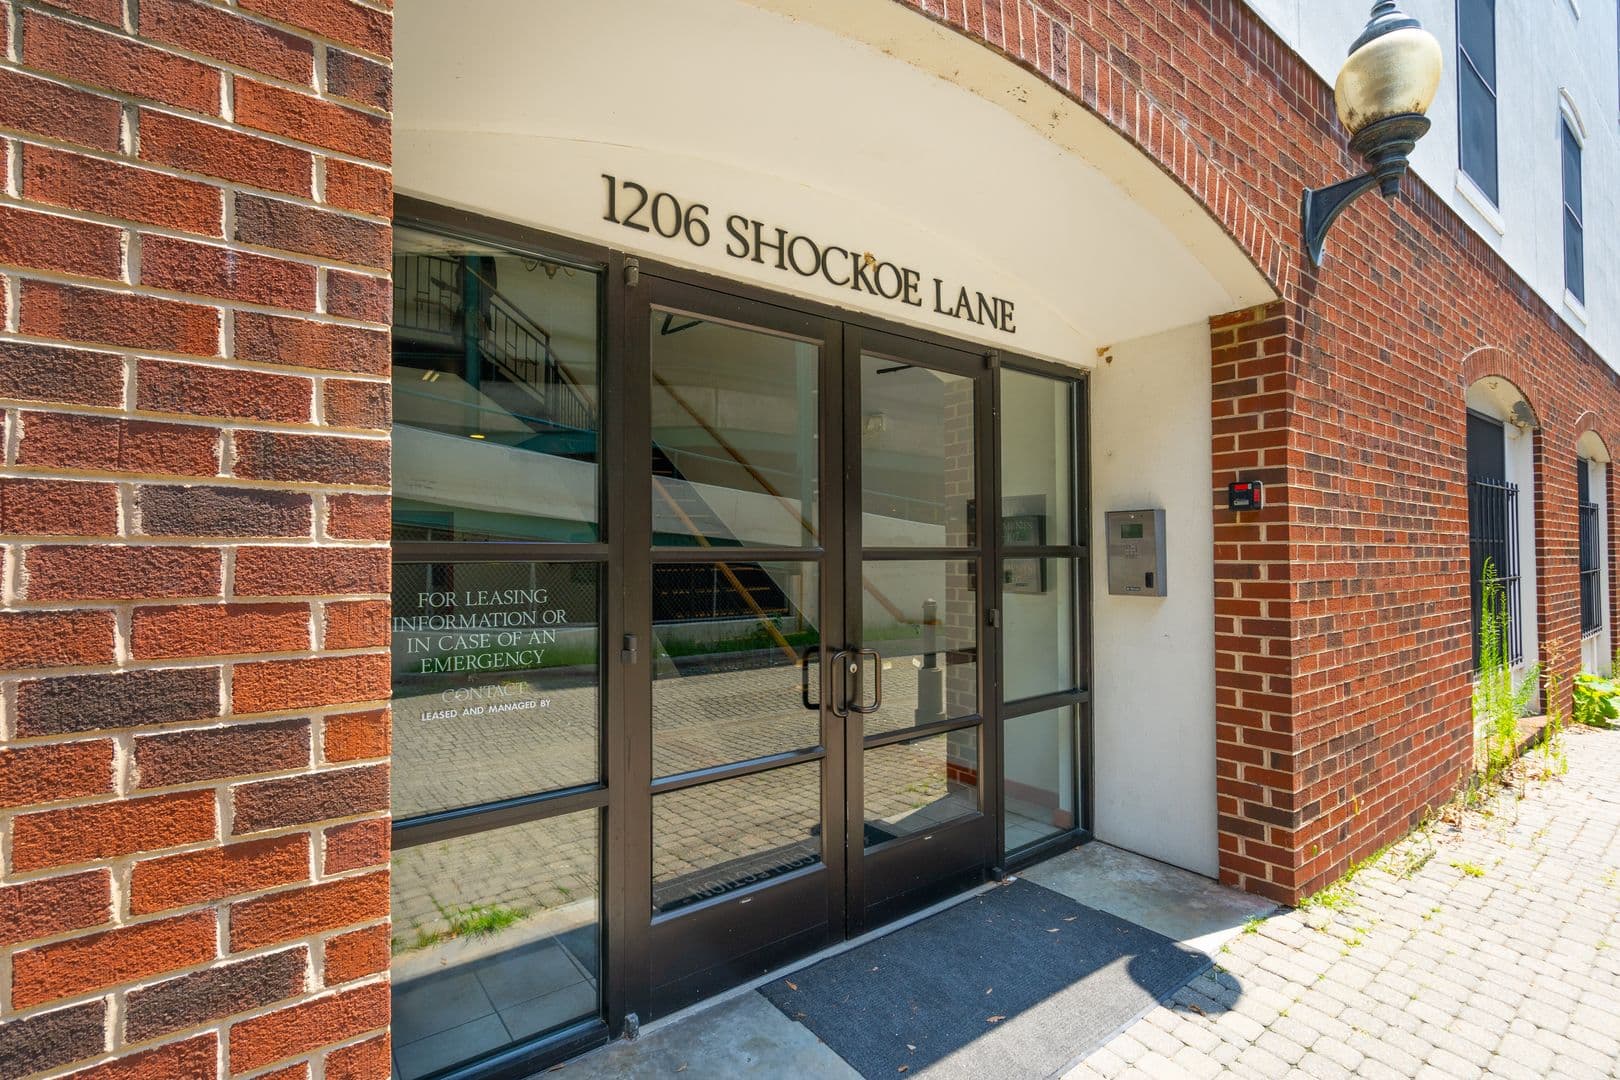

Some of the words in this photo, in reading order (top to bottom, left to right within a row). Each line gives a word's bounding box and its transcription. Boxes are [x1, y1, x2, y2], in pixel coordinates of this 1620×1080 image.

[601, 173, 710, 247] 1206
[725, 214, 923, 307] SHOCKOE
[933, 278, 1016, 333] LANE
[418, 592, 457, 608] FOR
[466, 589, 548, 607] LEASING
[393, 611, 537, 633] INFORMATION
[543, 610, 567, 625] OR
[408, 637, 432, 653] IN
[439, 634, 490, 651] CASE
[497, 631, 522, 647] OF
[528, 629, 557, 645] AN
[421, 650, 545, 674] EMERGENCY
[441, 682, 529, 703] CONTACT
[421, 710, 457, 722] LEASED
[463, 706, 484, 716] AND
[488, 701, 537, 714] MANAGED
[540, 699, 551, 708] BY
